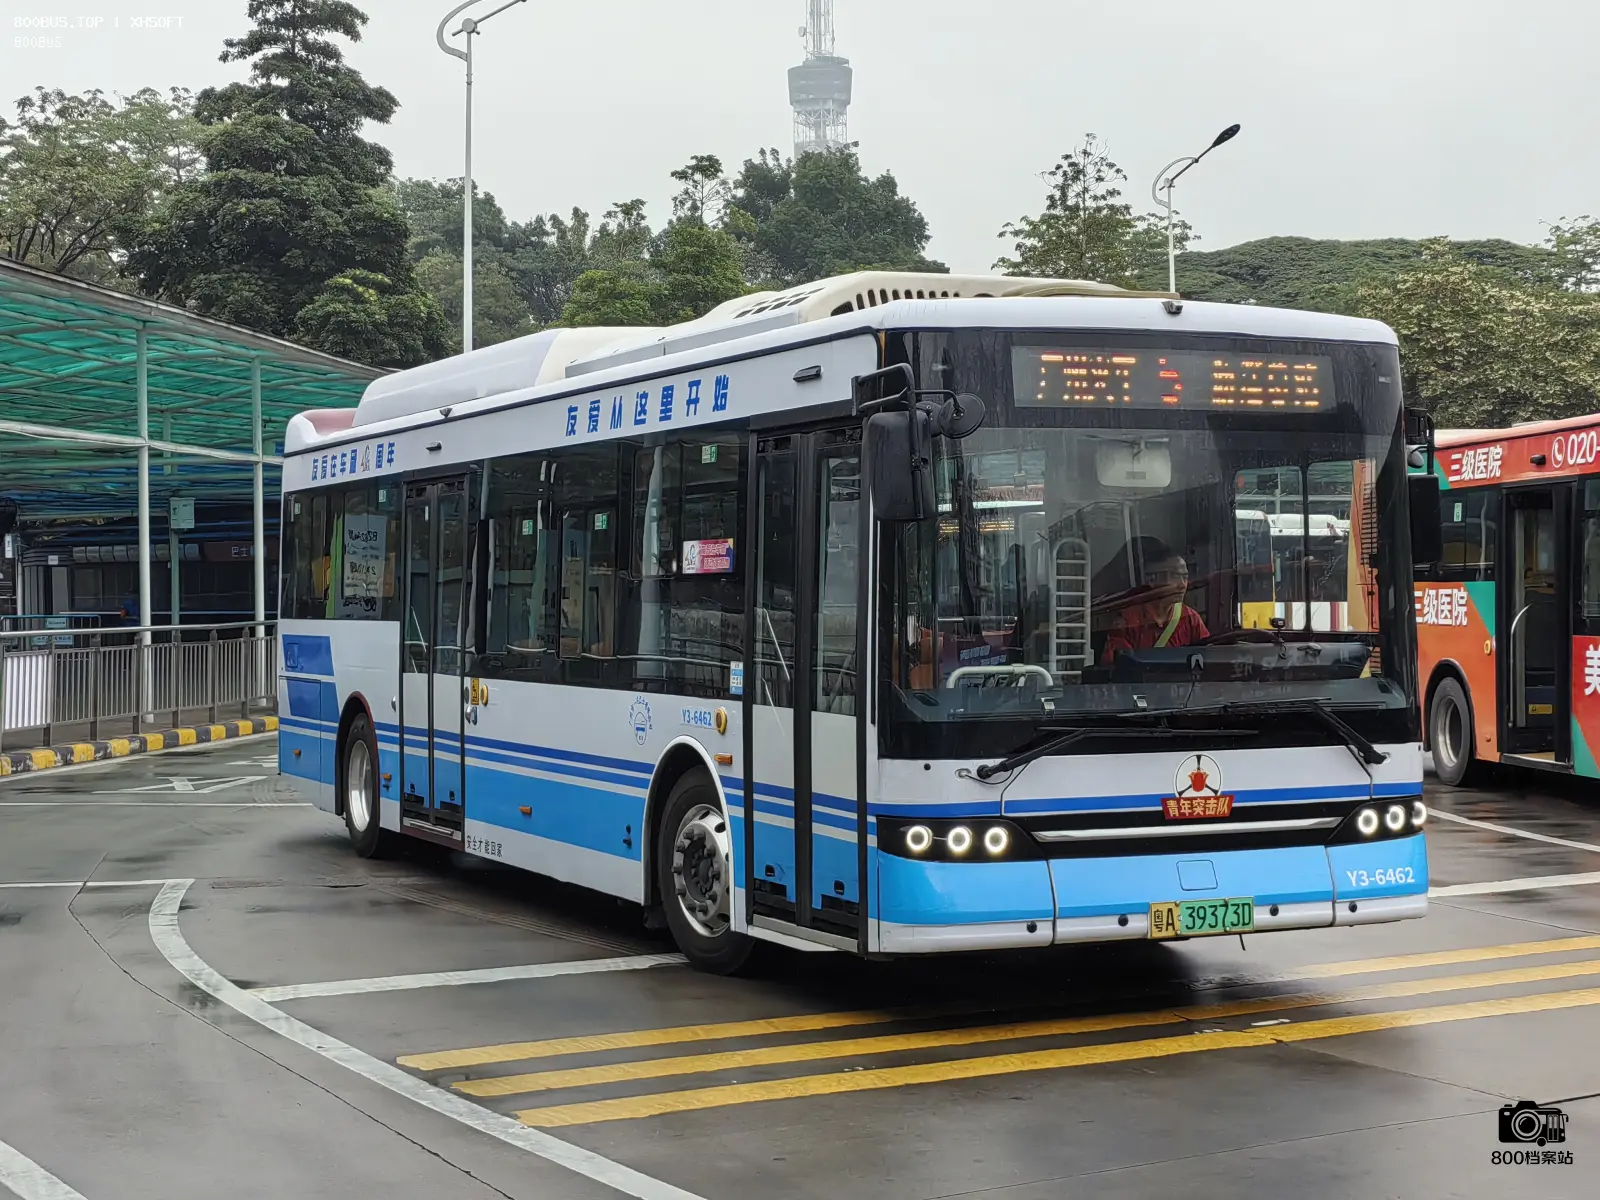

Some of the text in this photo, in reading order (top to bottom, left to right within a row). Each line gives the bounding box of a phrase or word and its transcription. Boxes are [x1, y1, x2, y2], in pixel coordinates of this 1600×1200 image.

[565, 374, 729, 436] 友爱从这里开始
[1448, 446, 1502, 481] 三级医院
[1414, 587, 1468, 626] 三级医院
[682, 708, 712, 727] Y3-6462
[1166, 797, 1231, 817] 青年突击队
[1346, 867, 1415, 887] Y3-6462
